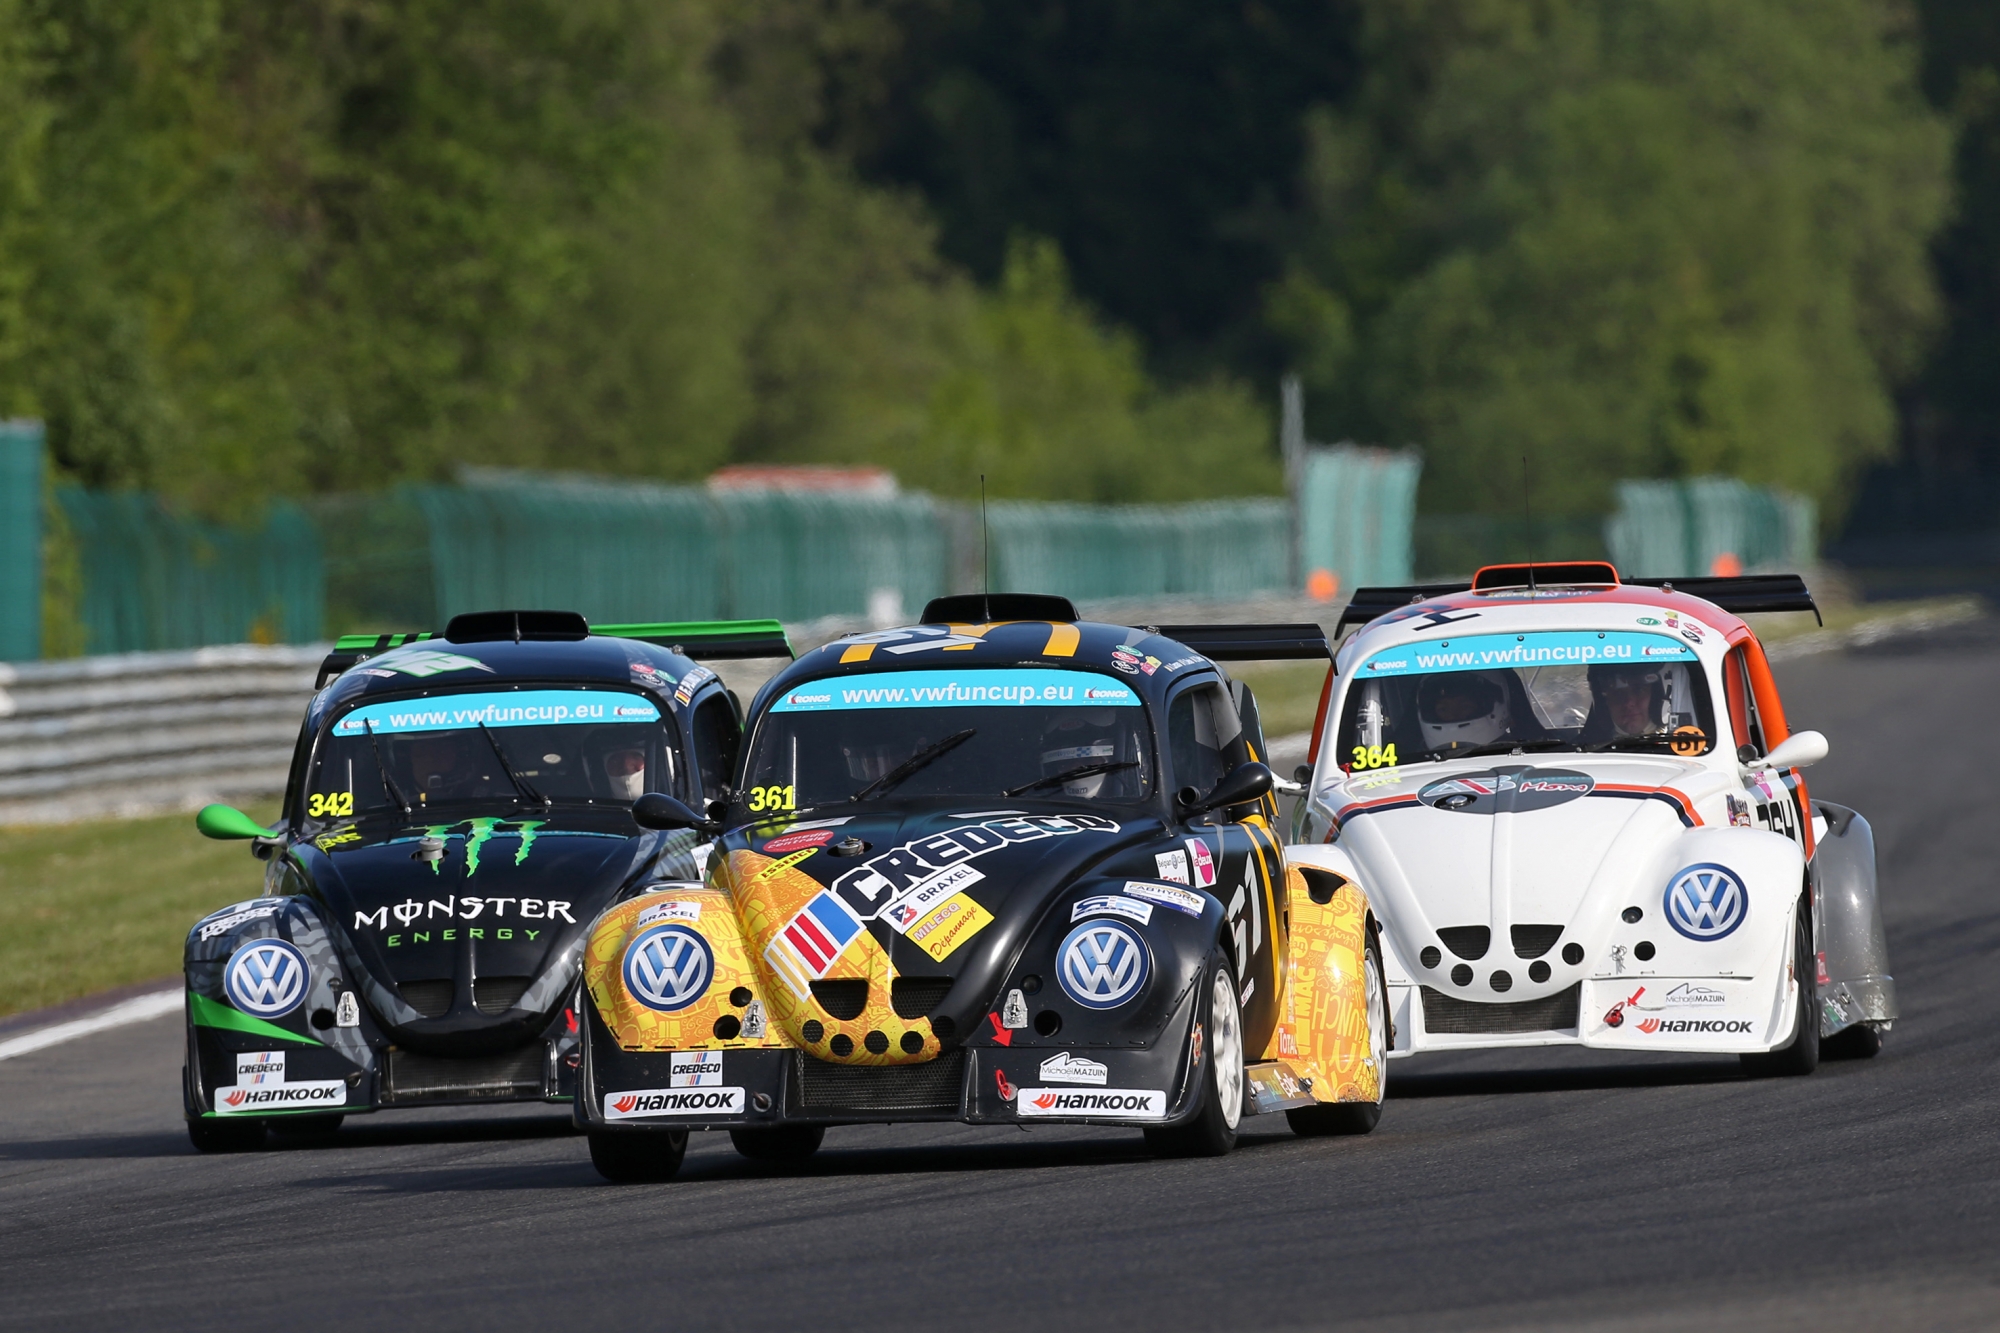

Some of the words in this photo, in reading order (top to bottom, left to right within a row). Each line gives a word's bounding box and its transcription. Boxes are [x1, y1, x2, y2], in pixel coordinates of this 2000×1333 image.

[1416, 644, 1632, 669] www.vwfuncup.eu
[786, 692, 832, 704] KRONOS
[842, 681, 1074, 706] www.vwfuncup.eu
[1084, 687, 1129, 698] KRONOS
[389, 704, 603, 728] www.vwfuncup.eu
[1351, 743, 1398, 770] 364
[308, 792, 354, 817] 342
[749, 785, 796, 811] 361
[761, 848, 815, 878] ESSENCE
[831, 814, 1121, 920] CREDECO
[917, 869, 974, 903] BRAXEL
[638, 911, 697, 927] BRAXEL
[913, 903, 961, 942] MILECQ
[387, 928, 540, 948] ENERGY
[238, 1062, 284, 1074] CREDECO
[672, 1063, 721, 1075] CREDECO
